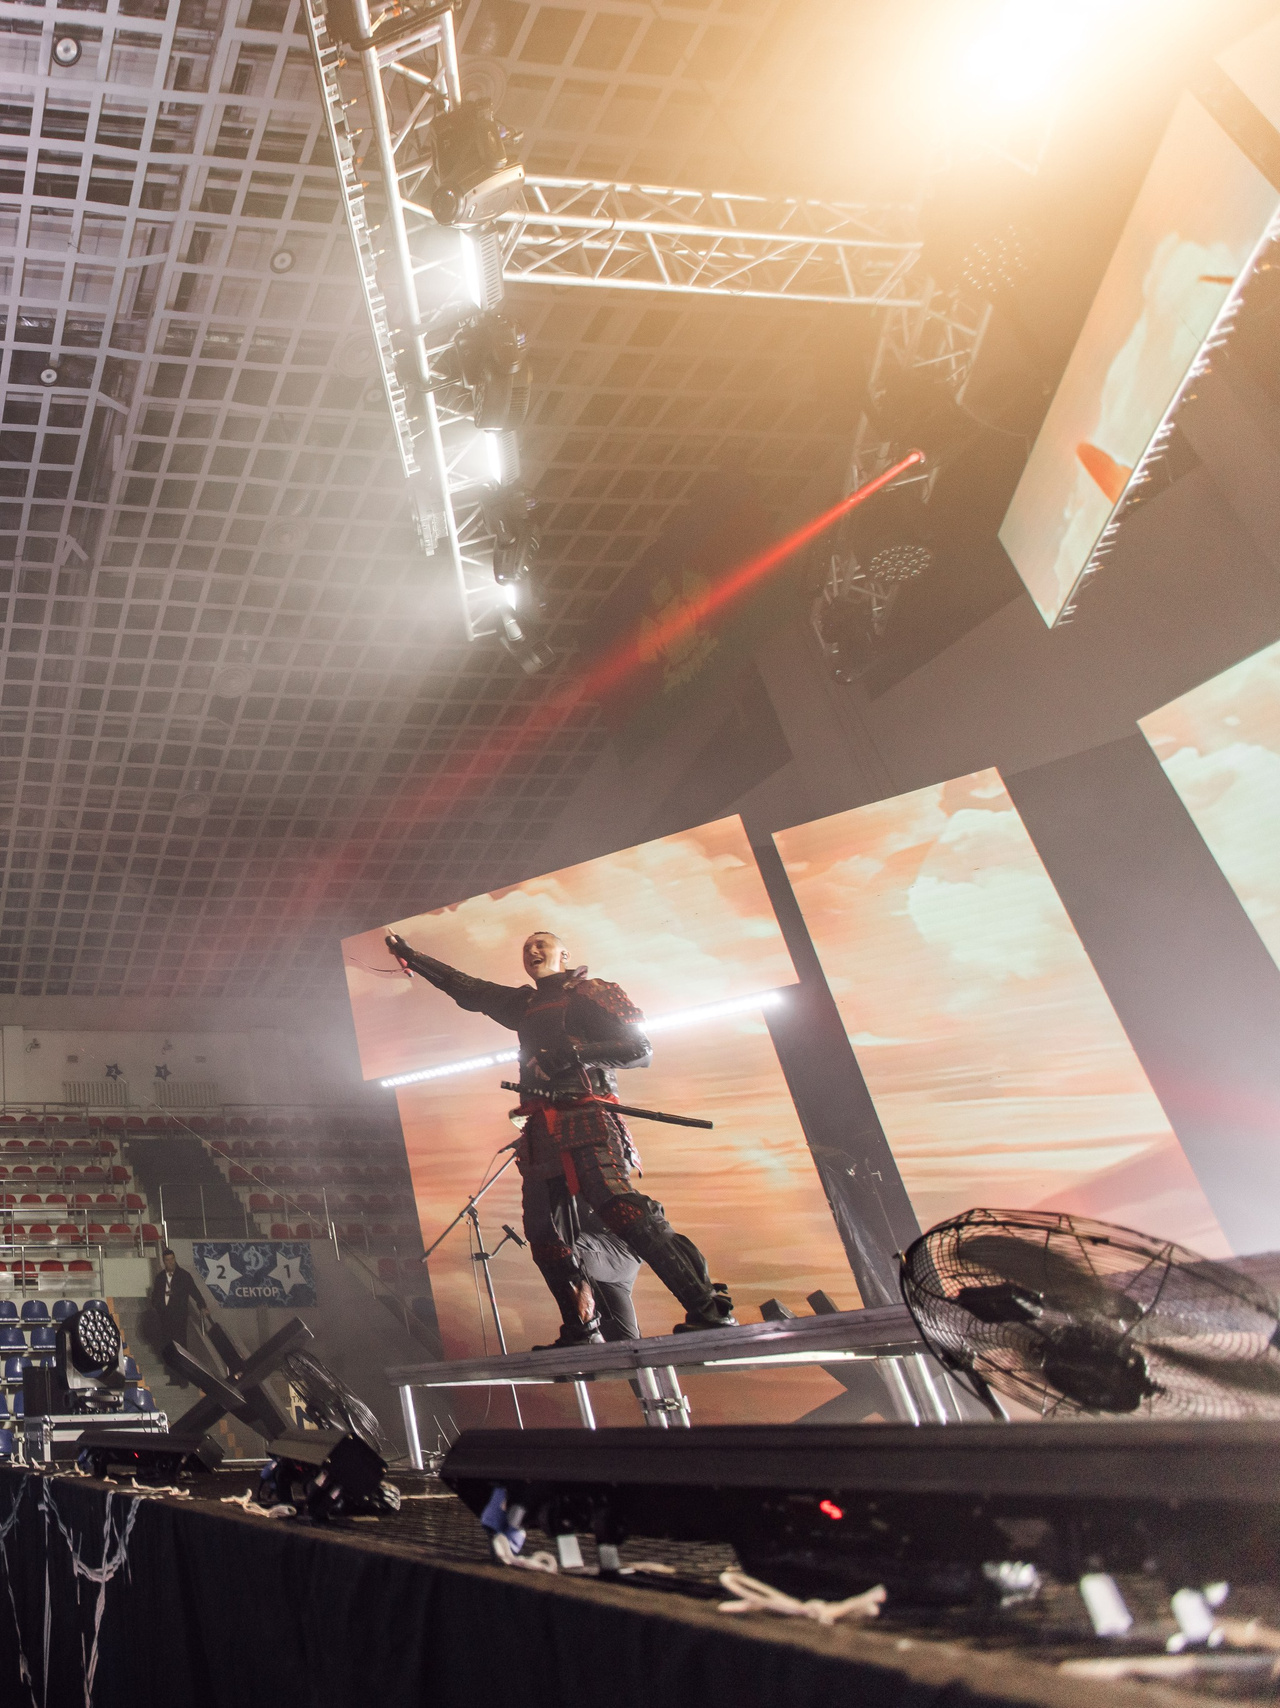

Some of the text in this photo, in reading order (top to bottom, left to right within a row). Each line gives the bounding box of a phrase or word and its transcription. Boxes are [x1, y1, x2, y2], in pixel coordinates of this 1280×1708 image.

[216, 1265, 227, 1279] 2
[283, 1264, 291, 1279] 1
[235, 1286, 279, 1298] СЕКТОР
